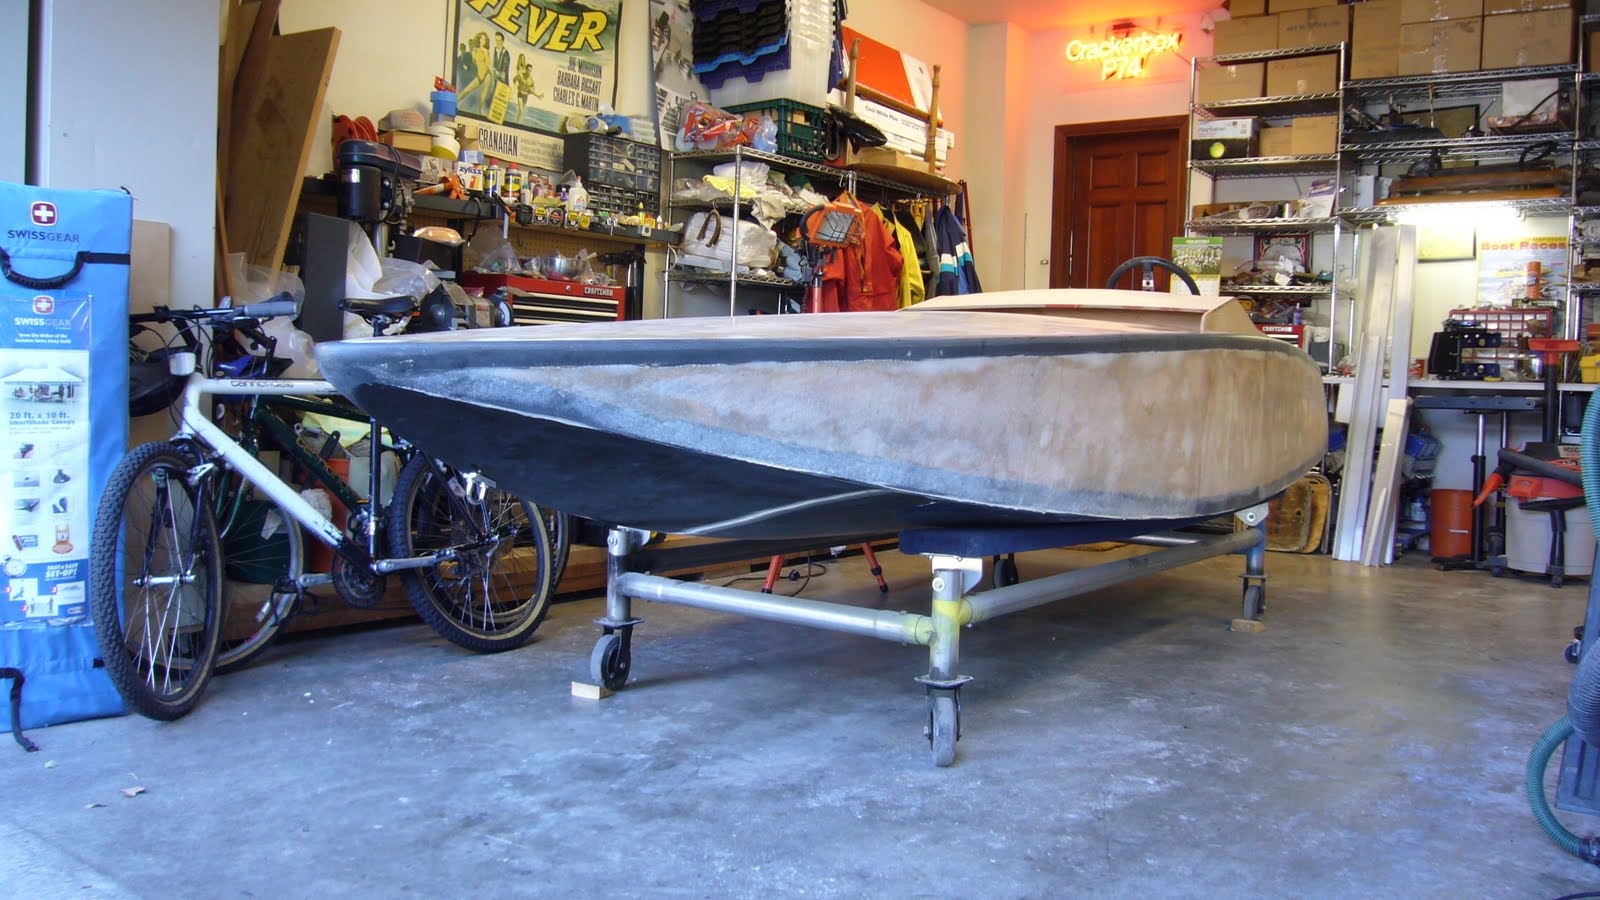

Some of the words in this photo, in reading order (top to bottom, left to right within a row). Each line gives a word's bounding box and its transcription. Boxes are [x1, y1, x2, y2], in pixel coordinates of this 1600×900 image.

[1065, 32, 1180, 61] Crackerbox
[1102, 56, 1141, 80] P74
[557, 70, 580, 90] BARBARA
[553, 86, 575, 106] CHARLES
[581, 93, 599, 112] MARTIN
[478, 127, 518, 157] GRANAHAN
[459, 166, 482, 175] zyliss
[8, 229, 80, 243] SWISSGEAR
[1481, 242, 1515, 250] Boat
[1520, 241, 1567, 250] Races
[14, 317, 72, 327] SWISSGEAR
[45, 569, 77, 578] SET-UP!
